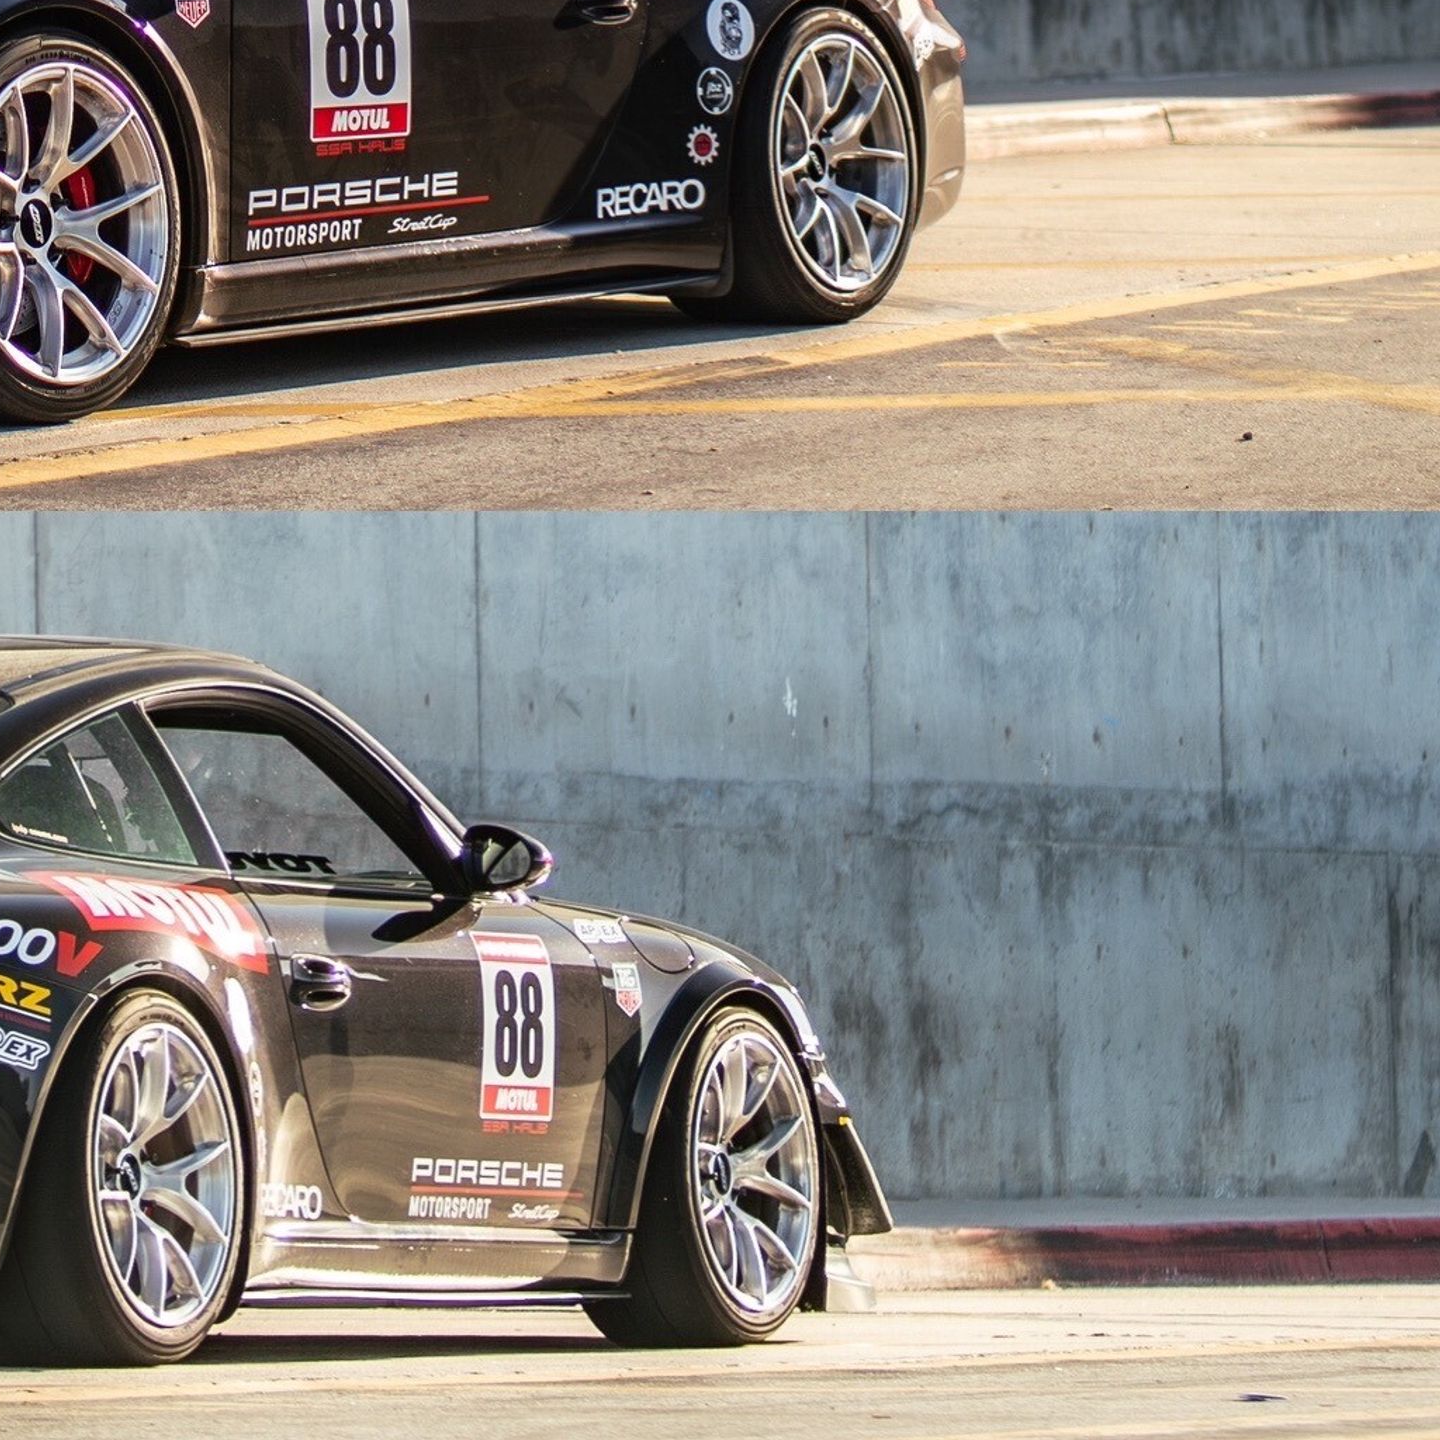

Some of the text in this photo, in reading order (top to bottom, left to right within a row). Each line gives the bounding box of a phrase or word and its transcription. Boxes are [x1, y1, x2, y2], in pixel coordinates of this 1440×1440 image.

[331, 107, 391, 133] MOTUL
[315, 138, 406, 157] SSA HAUS
[247, 171, 459, 216] PORSCHE
[596, 178, 706, 219] RECARO
[247, 218, 363, 251] MOTORSPORT
[494, 968, 544, 1078] 88
[494, 1087, 538, 1111] MOTUL
[410, 1157, 564, 1188] PORSCHE
[408, 1195, 492, 1219] MOTORSPORT
